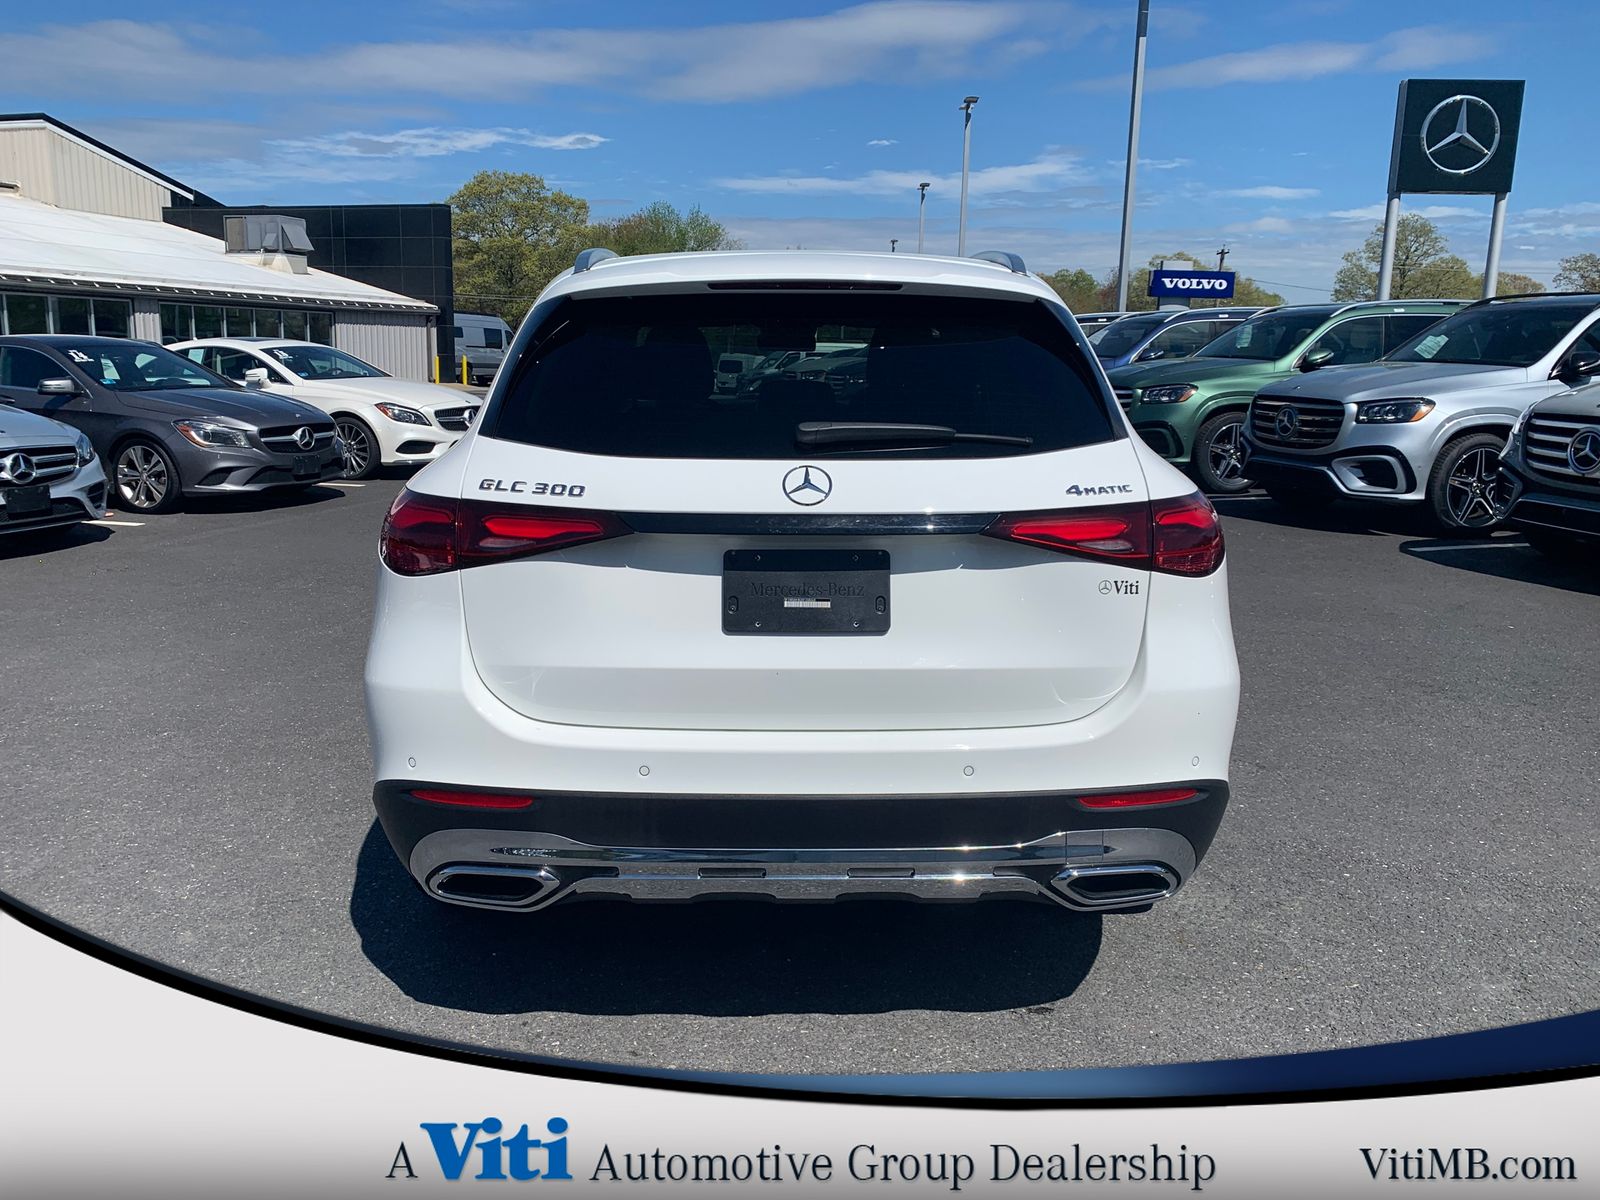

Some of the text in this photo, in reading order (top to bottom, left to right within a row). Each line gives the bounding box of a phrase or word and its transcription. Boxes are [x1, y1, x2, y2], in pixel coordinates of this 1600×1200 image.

[1161, 278, 1228, 290] VOLVO
[478, 478, 586, 497] GLC 300
[1065, 484, 1133, 496] 4MATIC
[751, 582, 865, 597] Mercedes-Benz
[1113, 580, 1140, 595] Viti
